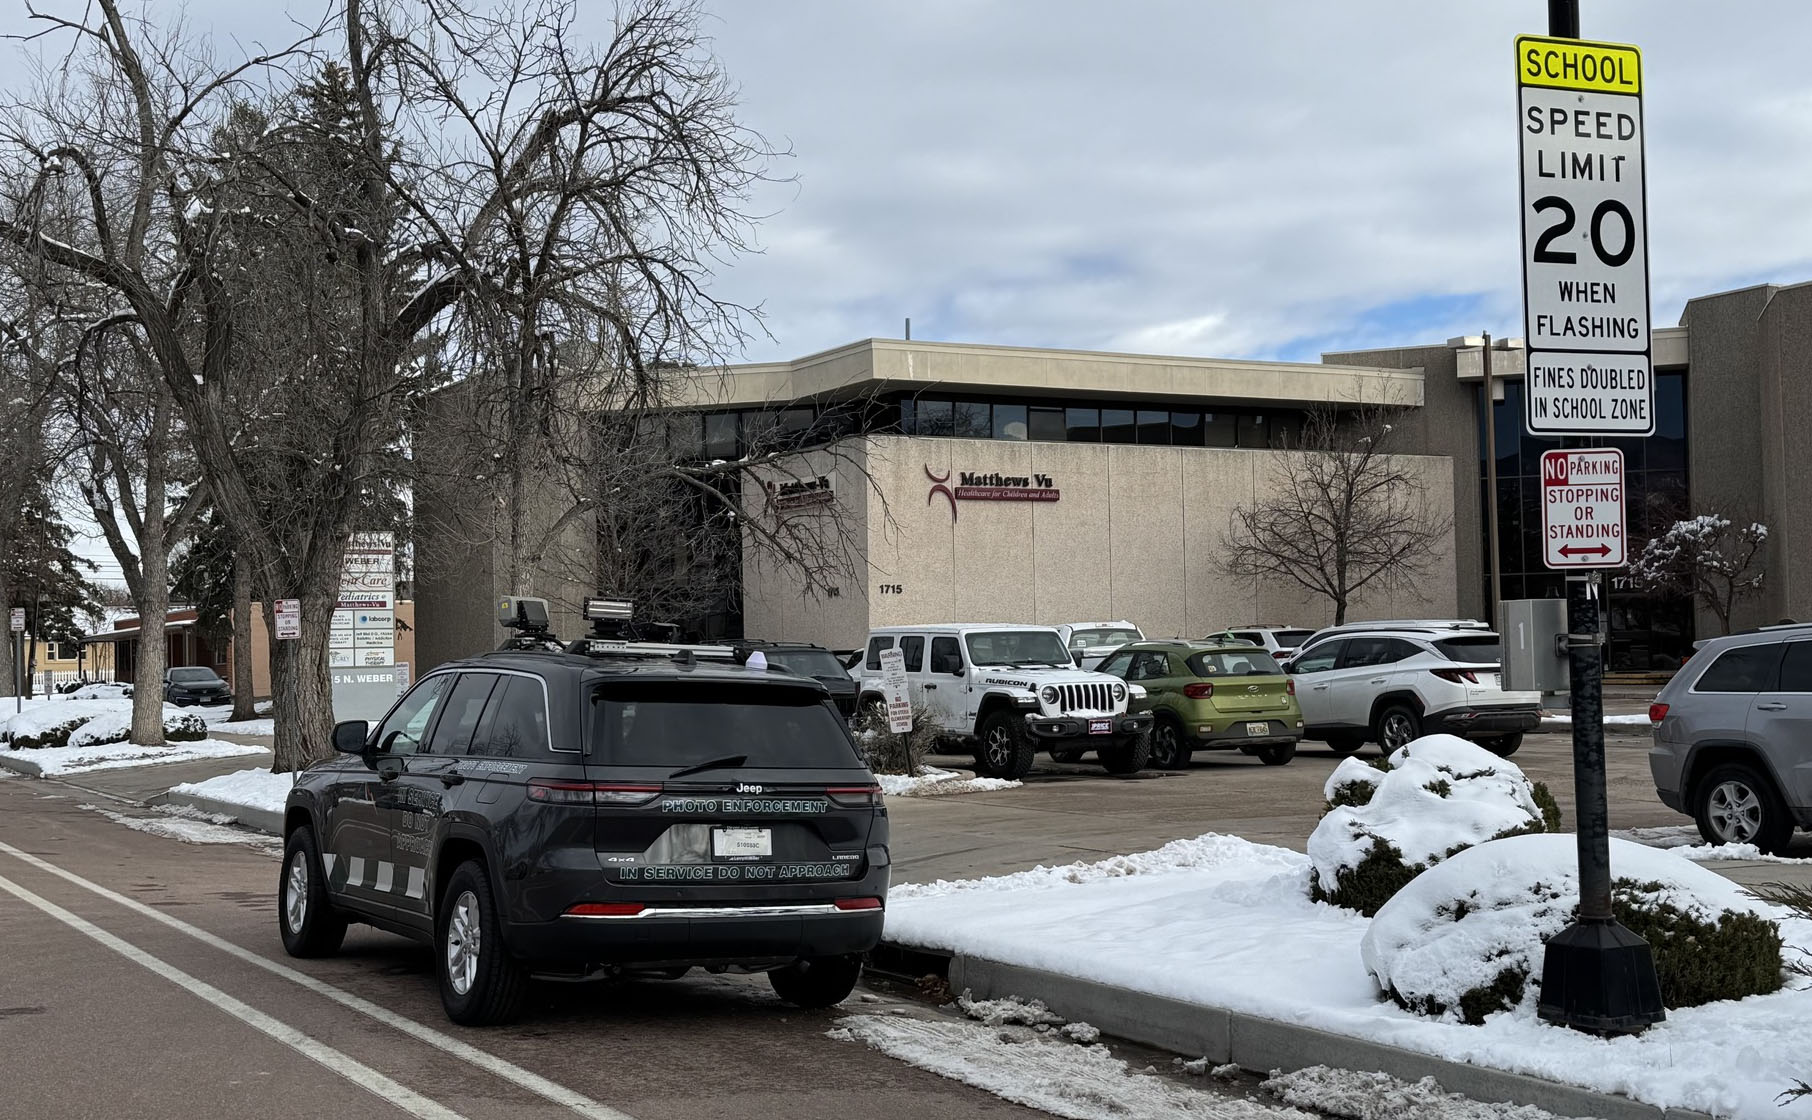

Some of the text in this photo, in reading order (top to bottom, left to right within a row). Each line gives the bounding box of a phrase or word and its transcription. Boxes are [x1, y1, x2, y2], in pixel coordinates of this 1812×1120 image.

[1526, 48, 1634, 85] SCHOOL
[1526, 105, 1636, 141] SPEED
[1537, 149, 1626, 183] LIMIT
[1531, 195, 1636, 268] 20
[1558, 280, 1616, 304] WHEN
[1537, 314, 1639, 339] FLASHING
[1534, 366, 1646, 391] FINES DOUBLED
[1534, 397, 1647, 420] IN SCHOOL ZONE
[1545, 458, 1619, 480] NO PARKING
[960, 471, 1053, 488] Matthews Vu
[958, 489, 991, 498] Healthcare
[1002, 490, 1028, 498] Children
[1028, 490, 1040, 498] and
[1548, 487, 1620, 504] STOPPING
[1574, 506, 1594, 521] OR
[1549, 523, 1620, 539] STANDING
[879, 584, 902, 594] 1715
[368, 615, 391, 623] labcorp
[357, 674, 393, 683] WEBER
[985, 678, 1028, 687] RUBICON
[736, 782, 763, 795] Jeep
[662, 799, 828, 813] PHOTO ENFORCEMENT
[620, 863, 850, 880] IN SERVICE DO NOT APPROACH
